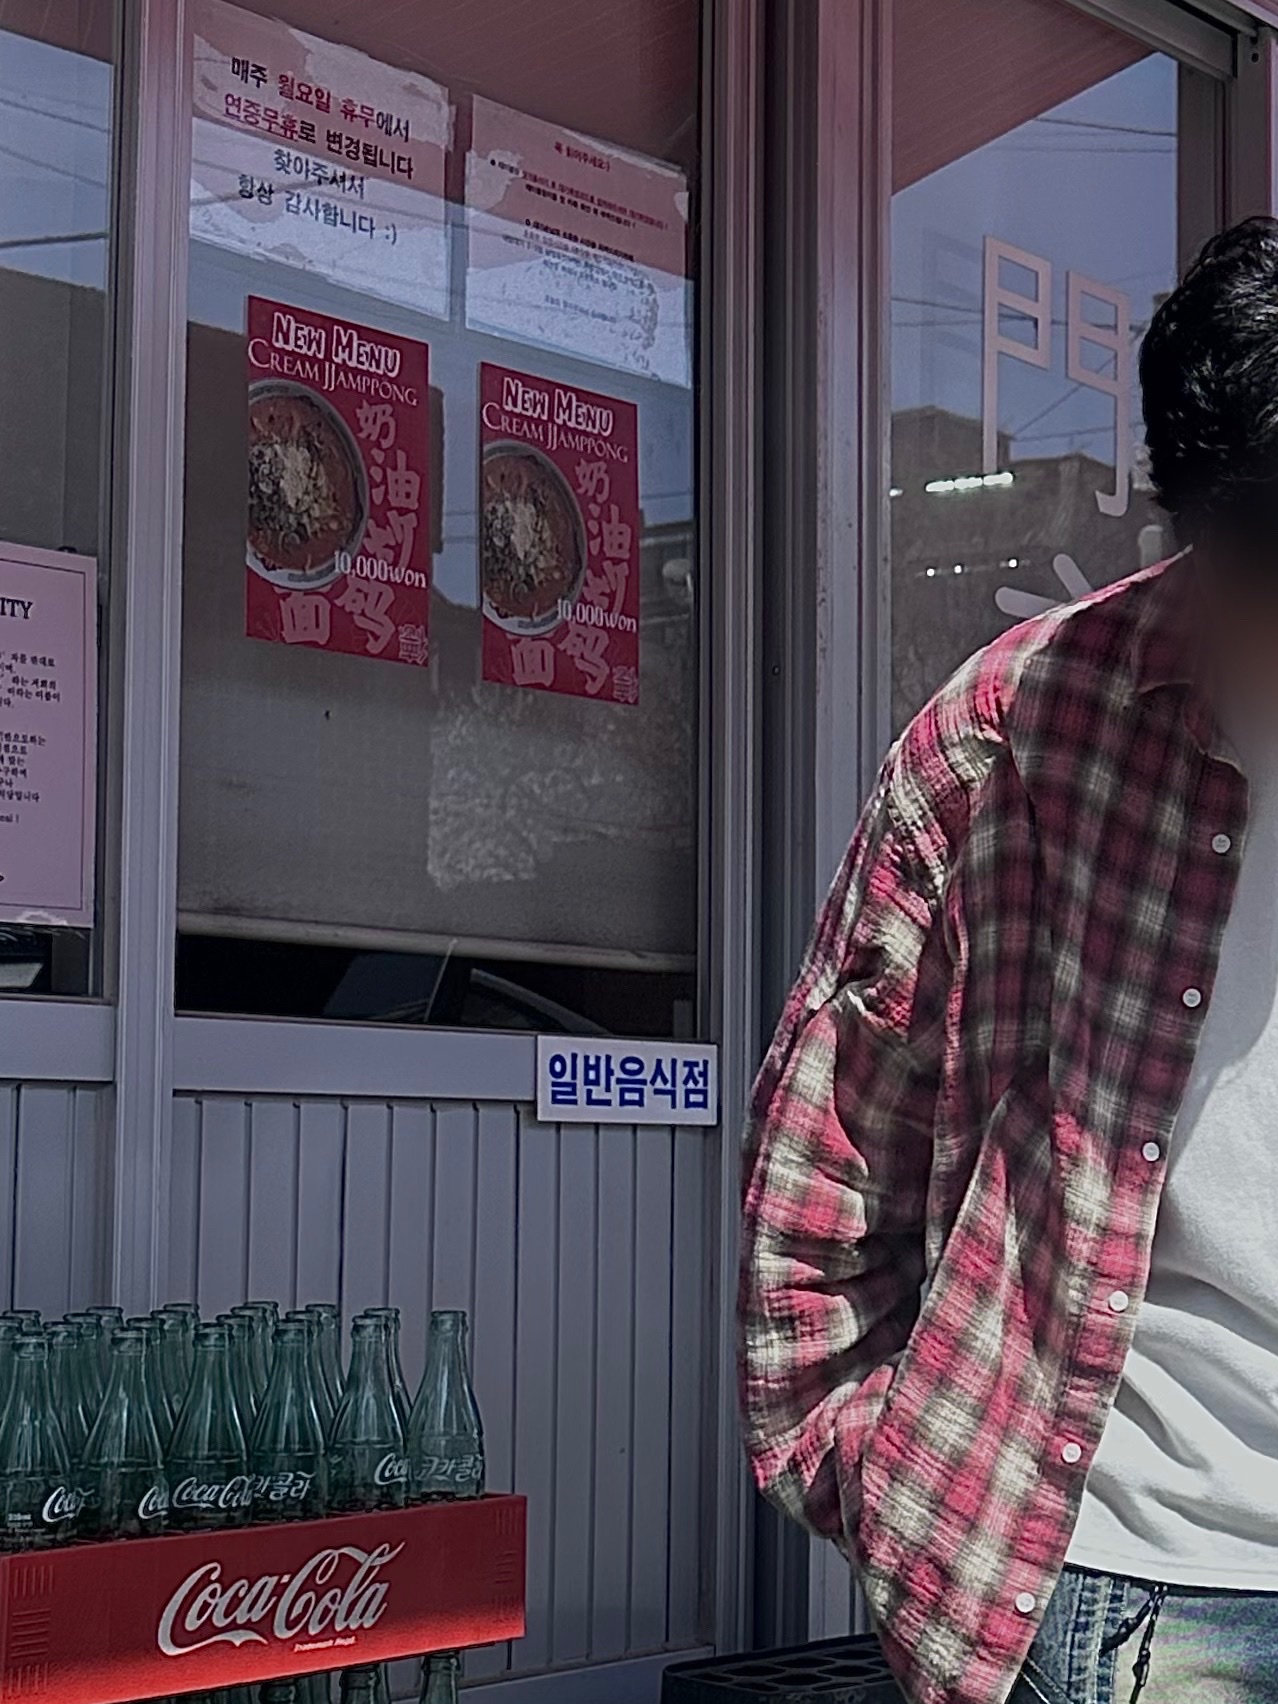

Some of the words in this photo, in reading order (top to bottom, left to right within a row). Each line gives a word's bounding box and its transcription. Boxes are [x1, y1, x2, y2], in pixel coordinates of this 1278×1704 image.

[231, 57, 268, 89] 매주
[278, 73, 331, 113] 월요일
[339, 98, 409, 142] 휴무에서
[223, 93, 316, 144] 연중무휴로
[326, 129, 414, 179] 변경됩니다
[273, 149, 365, 199] 찾아주셔서
[238, 173, 275, 206] 항상
[284, 190, 376, 240] 감사합니다
[248, 338, 319, 382] CREAM
[482, 402, 544, 442] CREAM
[334, 551, 427, 588] 10,000won
[557, 598, 637, 633] 10,000won
[549, 1052, 709, 1110] 일반음식점
[158, 1541, 406, 1657] Coca-Cola
